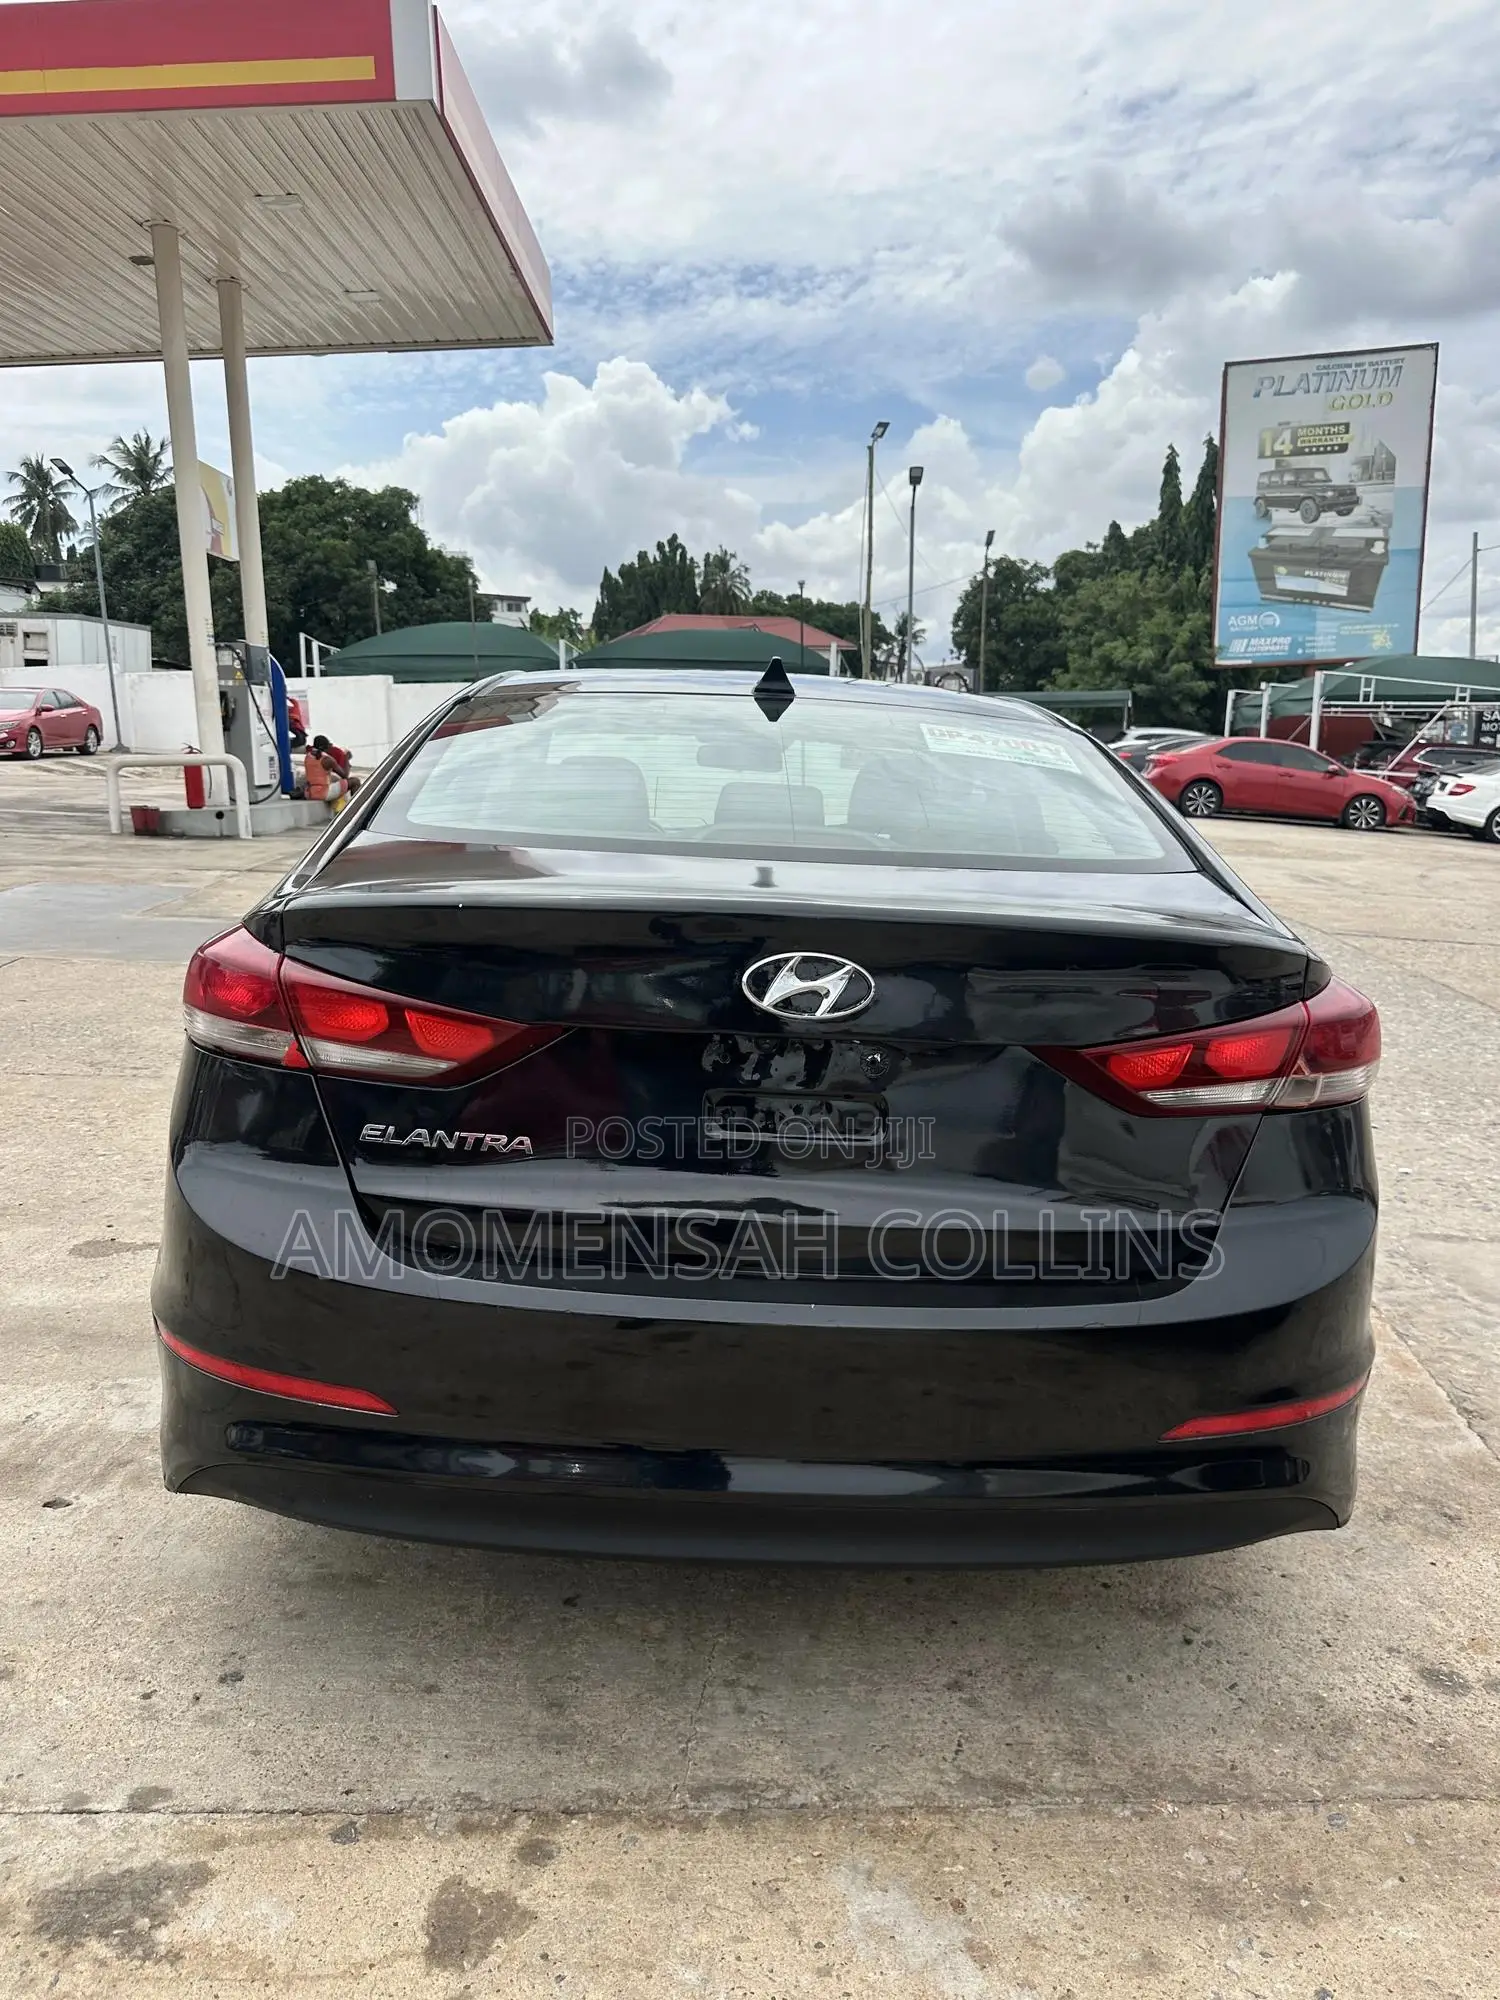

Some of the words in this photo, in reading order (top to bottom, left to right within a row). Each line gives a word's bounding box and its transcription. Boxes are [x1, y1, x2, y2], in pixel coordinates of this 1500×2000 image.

[1252, 365, 1403, 399] PLATINUM
[1329, 391, 1394, 411] GOLD
[1261, 427, 1293, 457] 14
[1297, 424, 1347, 437] MONTHS
[1228, 614, 1258, 627] AGM
[359, 1123, 534, 1155] ELANTRA
